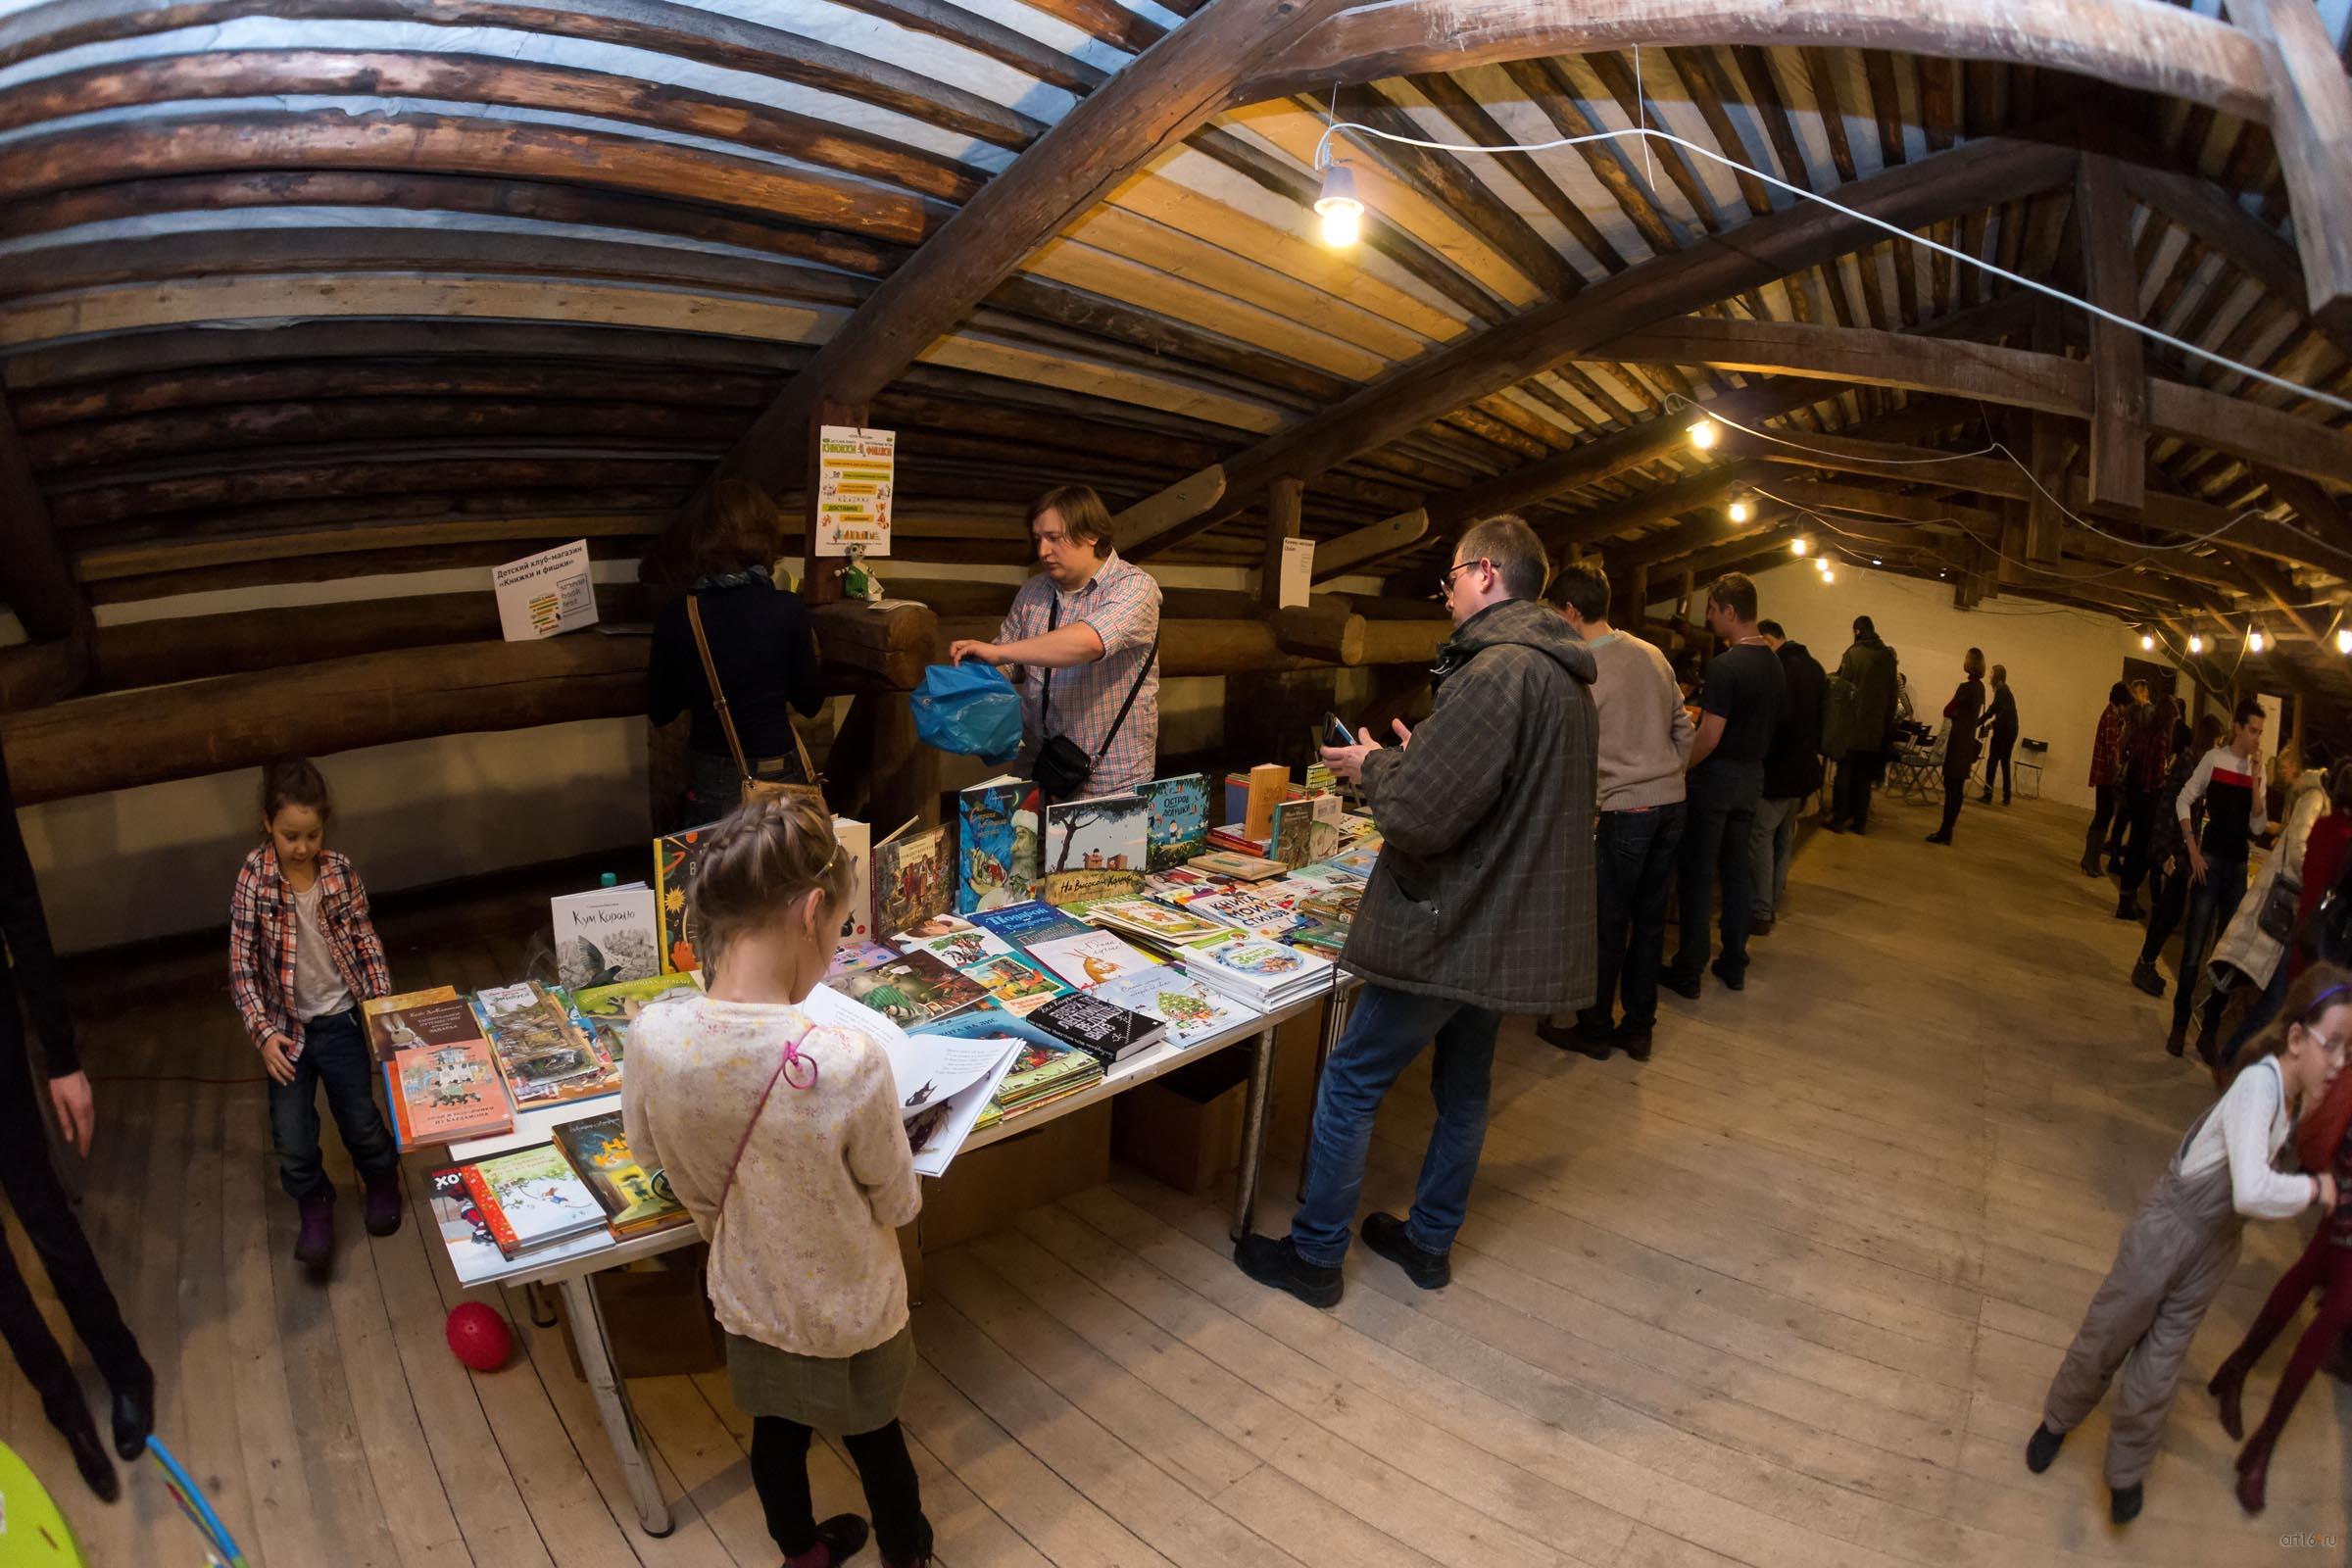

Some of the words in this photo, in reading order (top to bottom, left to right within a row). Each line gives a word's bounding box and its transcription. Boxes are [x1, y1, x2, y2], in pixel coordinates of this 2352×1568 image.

[497, 562, 529, 579] Детский
[530, 547, 582, 566] клуб-магазин
[499, 572, 534, 588] «Книжки
[543, 560, 574, 574] фишки»
[1164, 796, 1189, 808] ОСТРОВ
[1061, 878, 1072, 893] На
[1074, 877, 1105, 892] Высоком
[1209, 895, 1259, 910] КНИГА
[1229, 902, 1276, 919] МОИХ
[572, 910, 596, 929] Кум
[986, 907, 1050, 926] Подарок
[1242, 909, 1290, 926] СТИХОВ
[1058, 1004, 1110, 1030] ЛЕСТНИЦЕ
[1075, 1007, 1124, 1032] ВЕДУЩЕЙ
[1084, 1021, 1116, 1041] ВНИЗ
